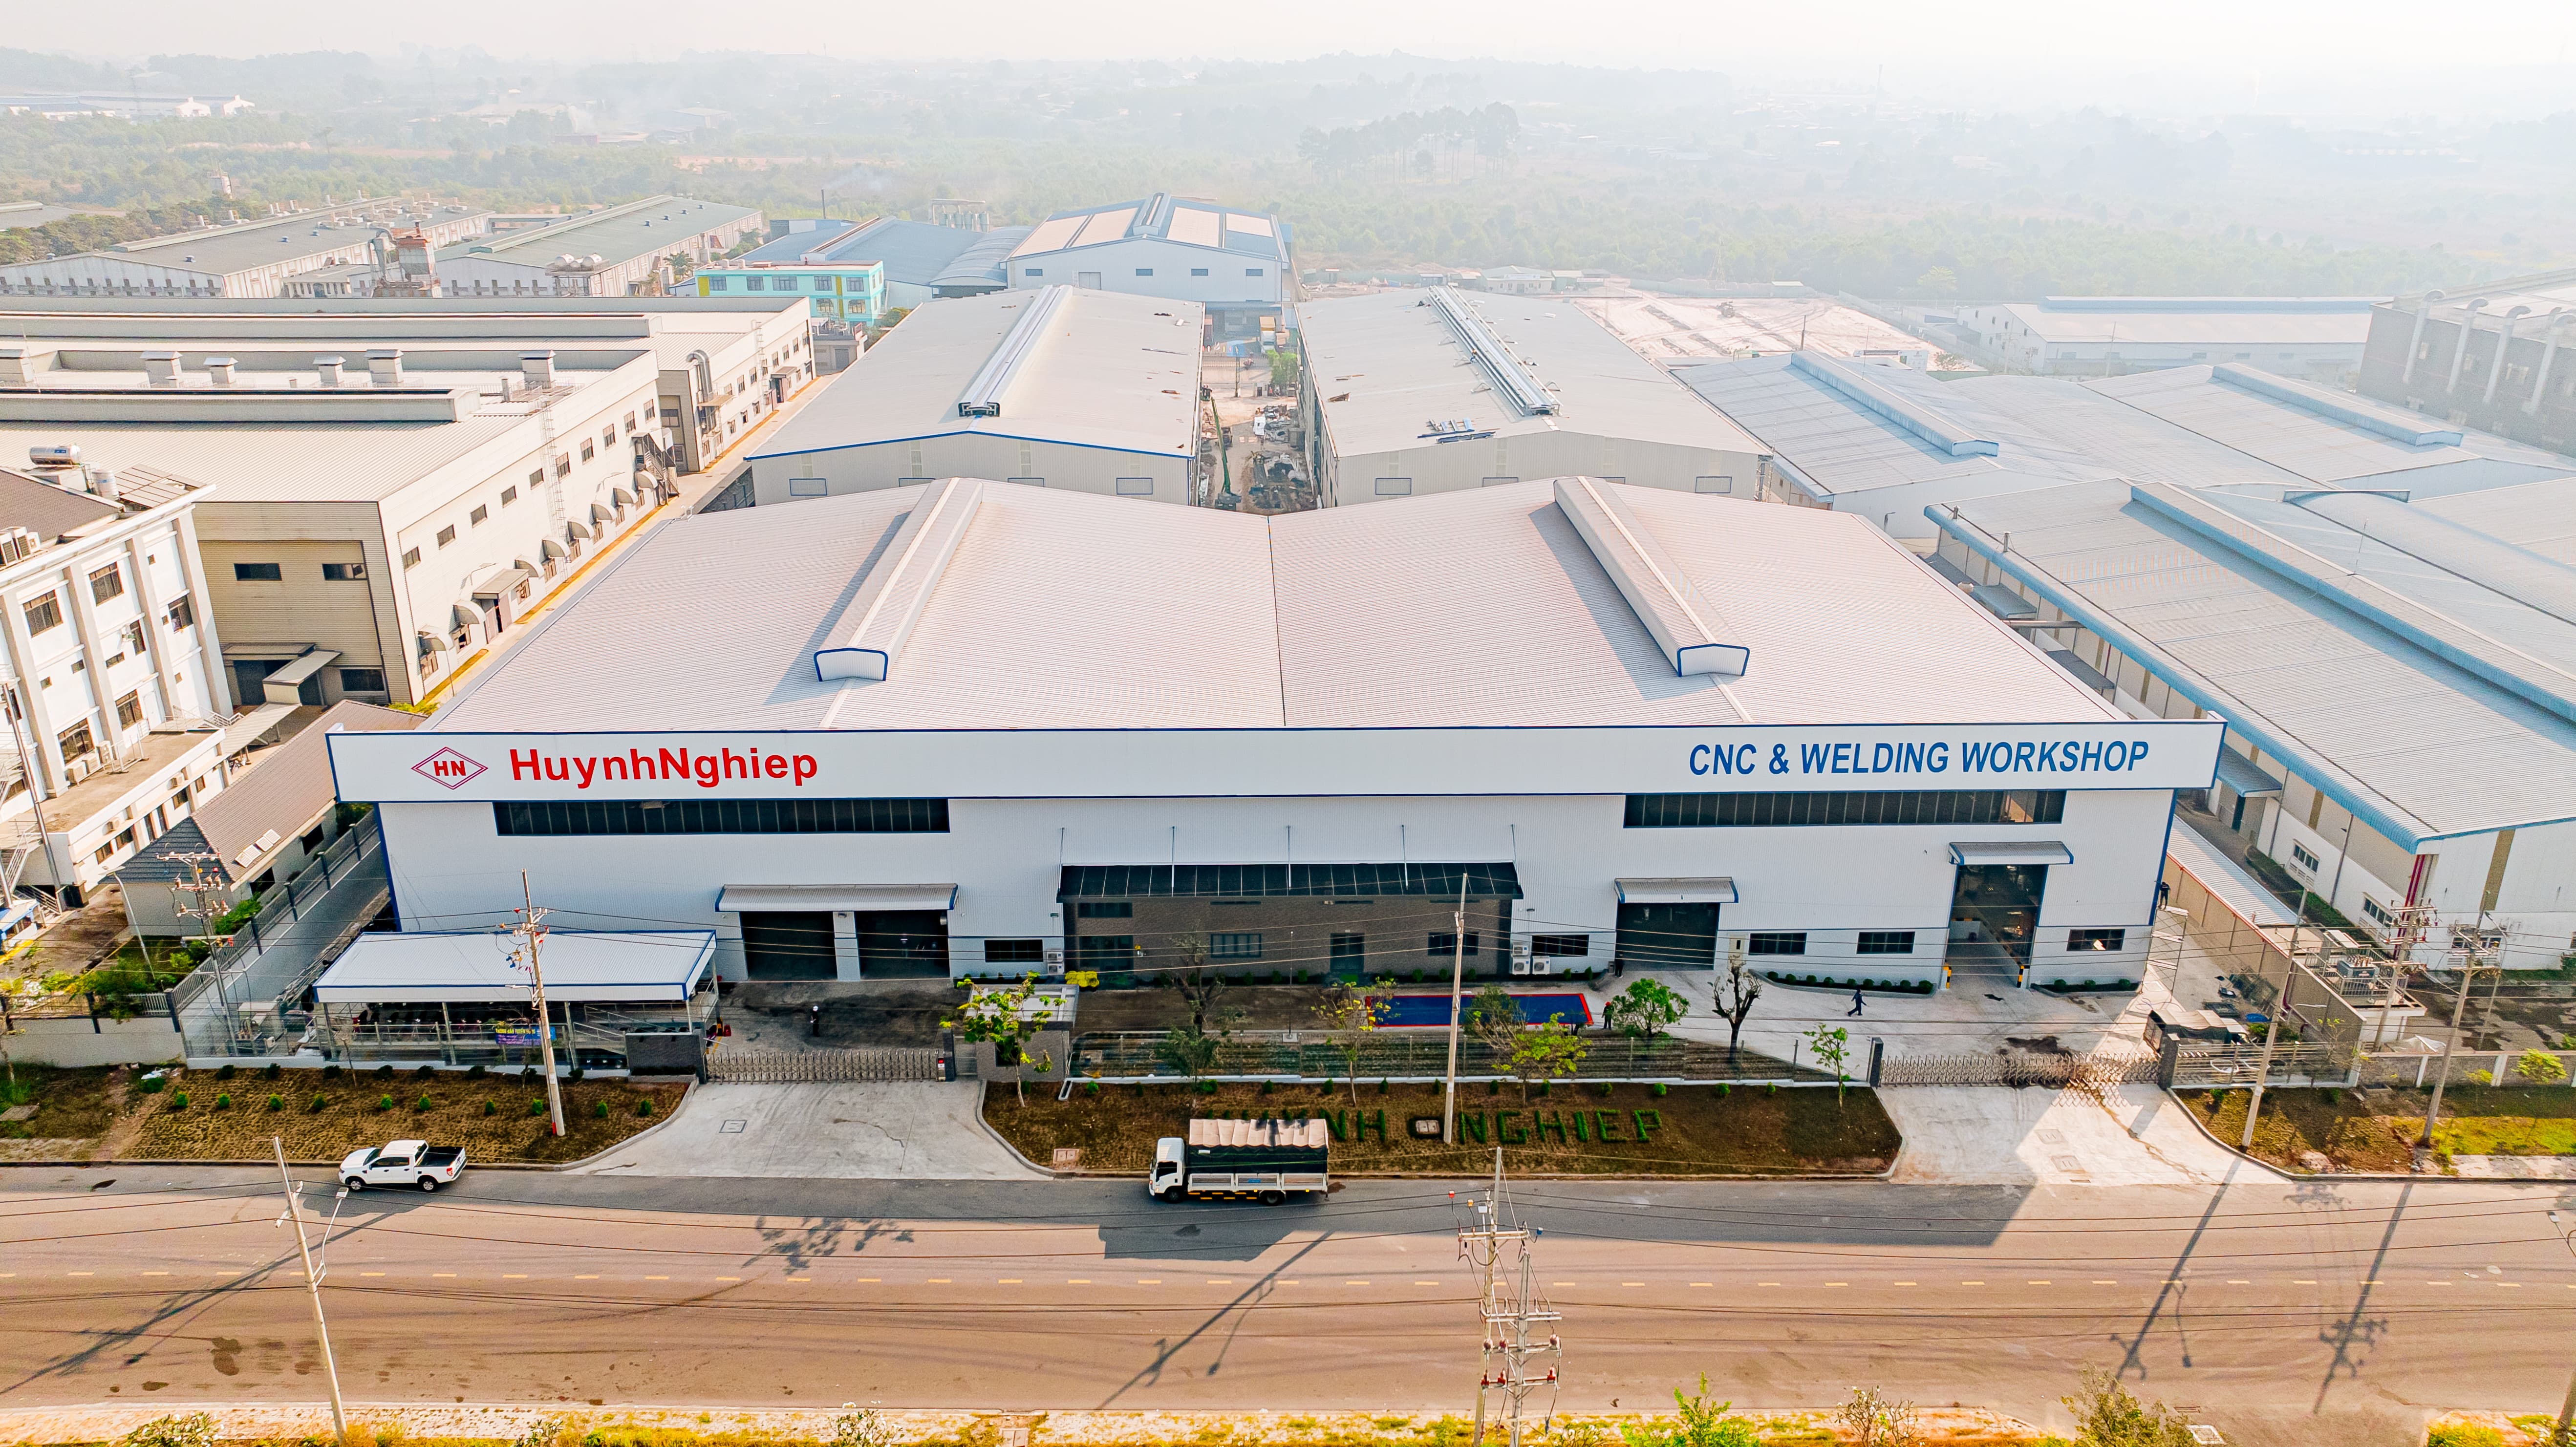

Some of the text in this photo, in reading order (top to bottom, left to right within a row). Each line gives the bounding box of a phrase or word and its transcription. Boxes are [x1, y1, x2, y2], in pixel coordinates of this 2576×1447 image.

[433, 761, 467, 777] HN
[510, 747, 817, 789] HuynhNghiep
[1689, 741, 2149, 776] CNC & WELDING WORKSHOP
